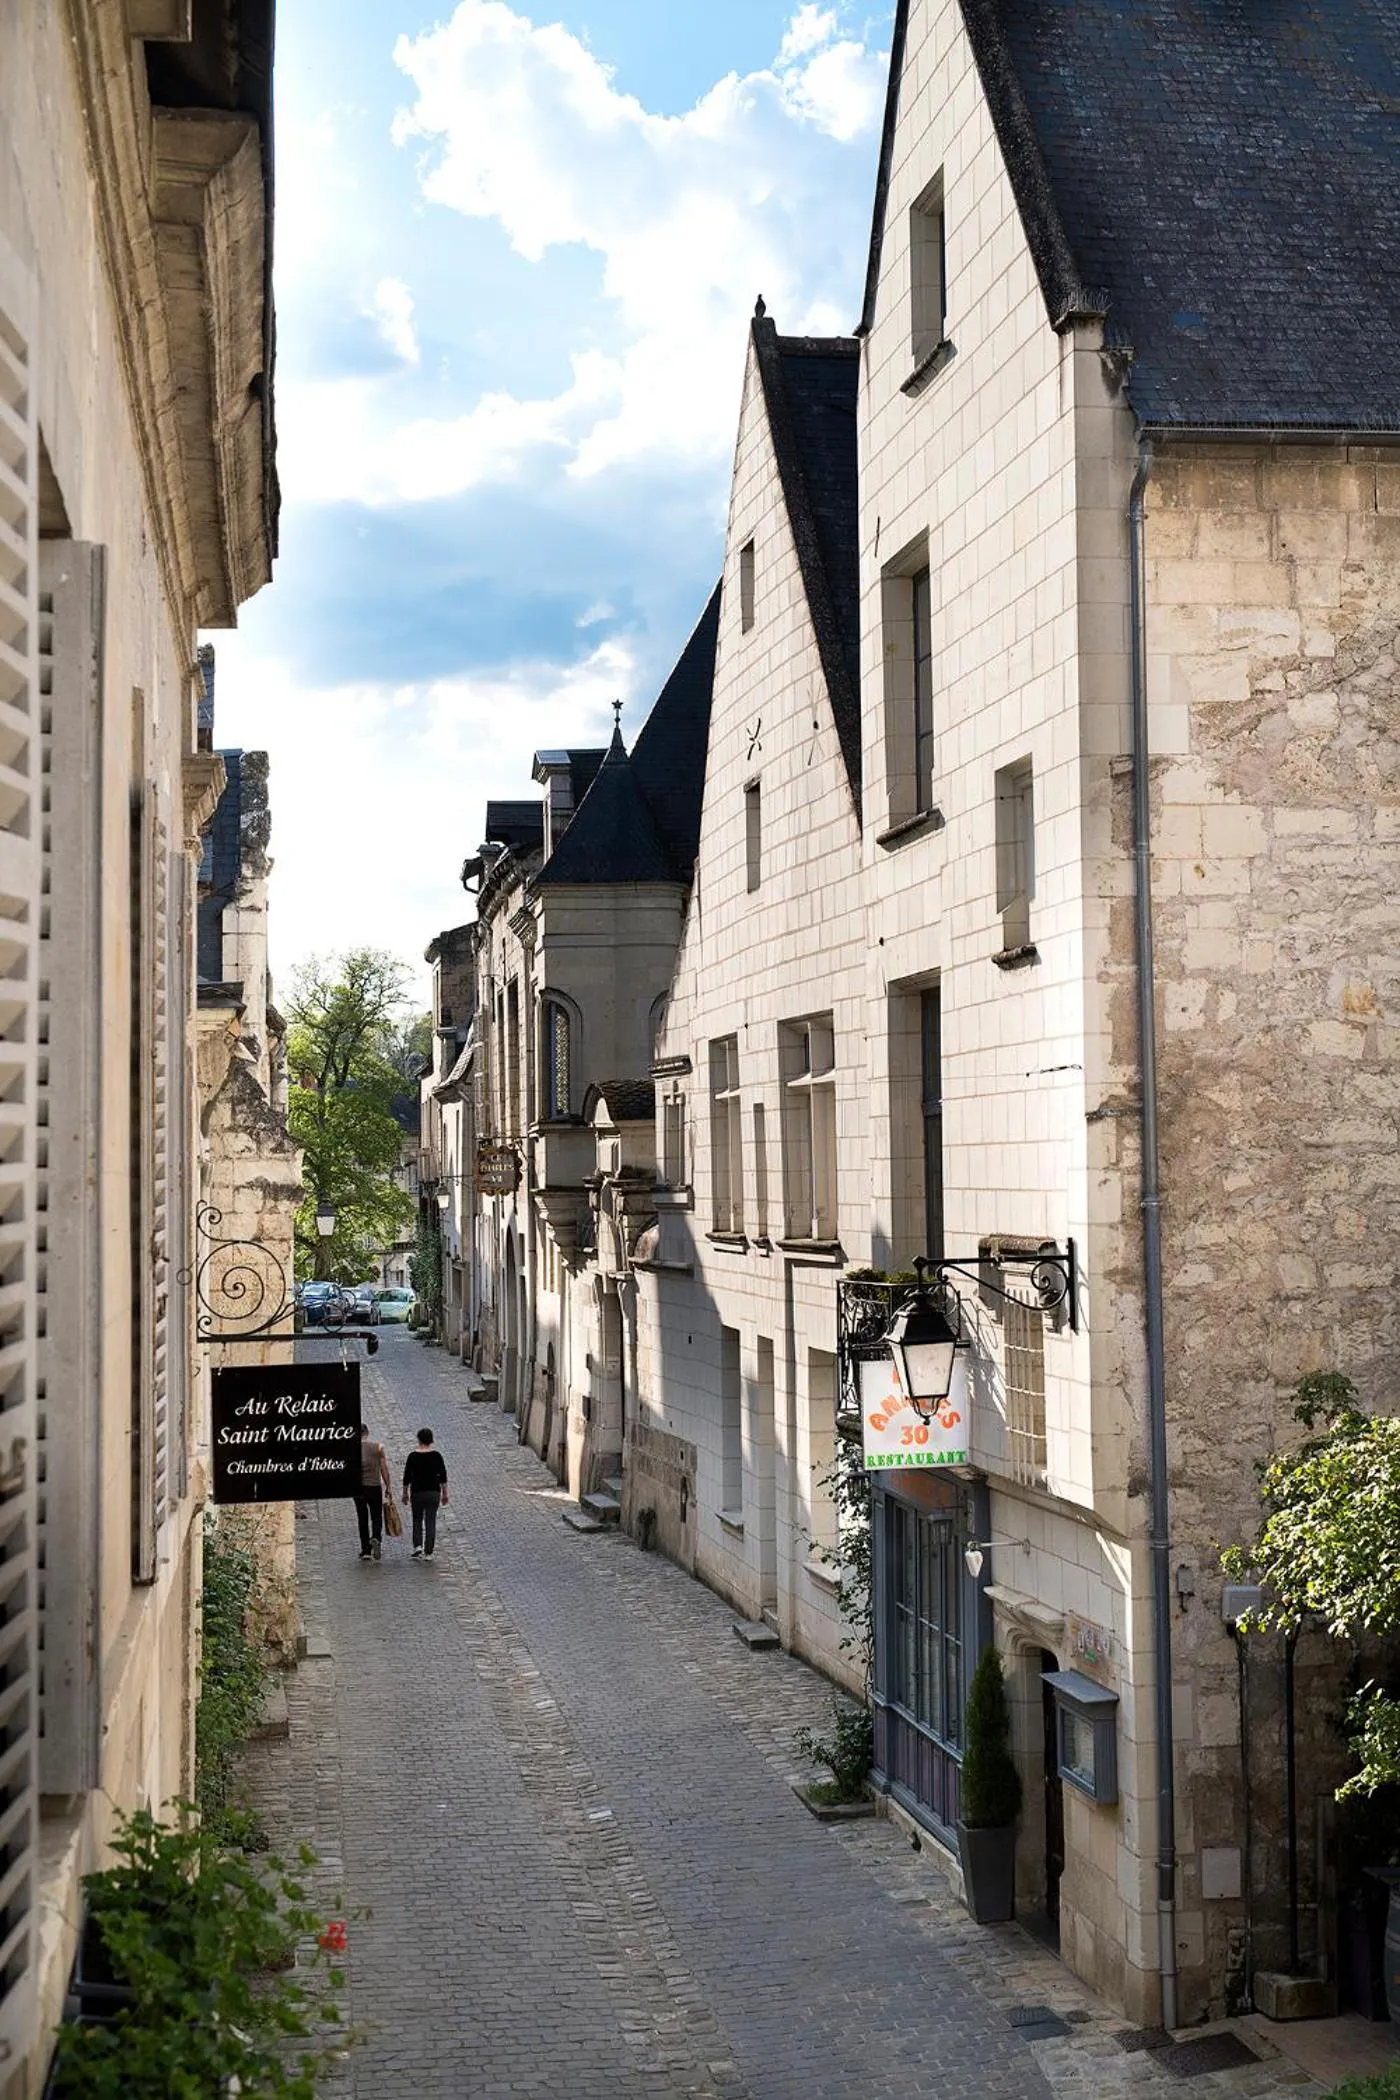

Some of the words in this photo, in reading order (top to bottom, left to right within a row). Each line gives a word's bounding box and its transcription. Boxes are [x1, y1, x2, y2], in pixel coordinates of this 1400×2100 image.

[235, 1398, 269, 1416] Au
[274, 1393, 336, 1417] Relais
[217, 1425, 269, 1445] Saint
[273, 1421, 355, 1442] Maurice
[901, 1425, 929, 1446] 30
[227, 1459, 294, 1475] Chambres
[297, 1456, 346, 1471] d'hôtes
[867, 1451, 966, 1467] RESTAURANT
